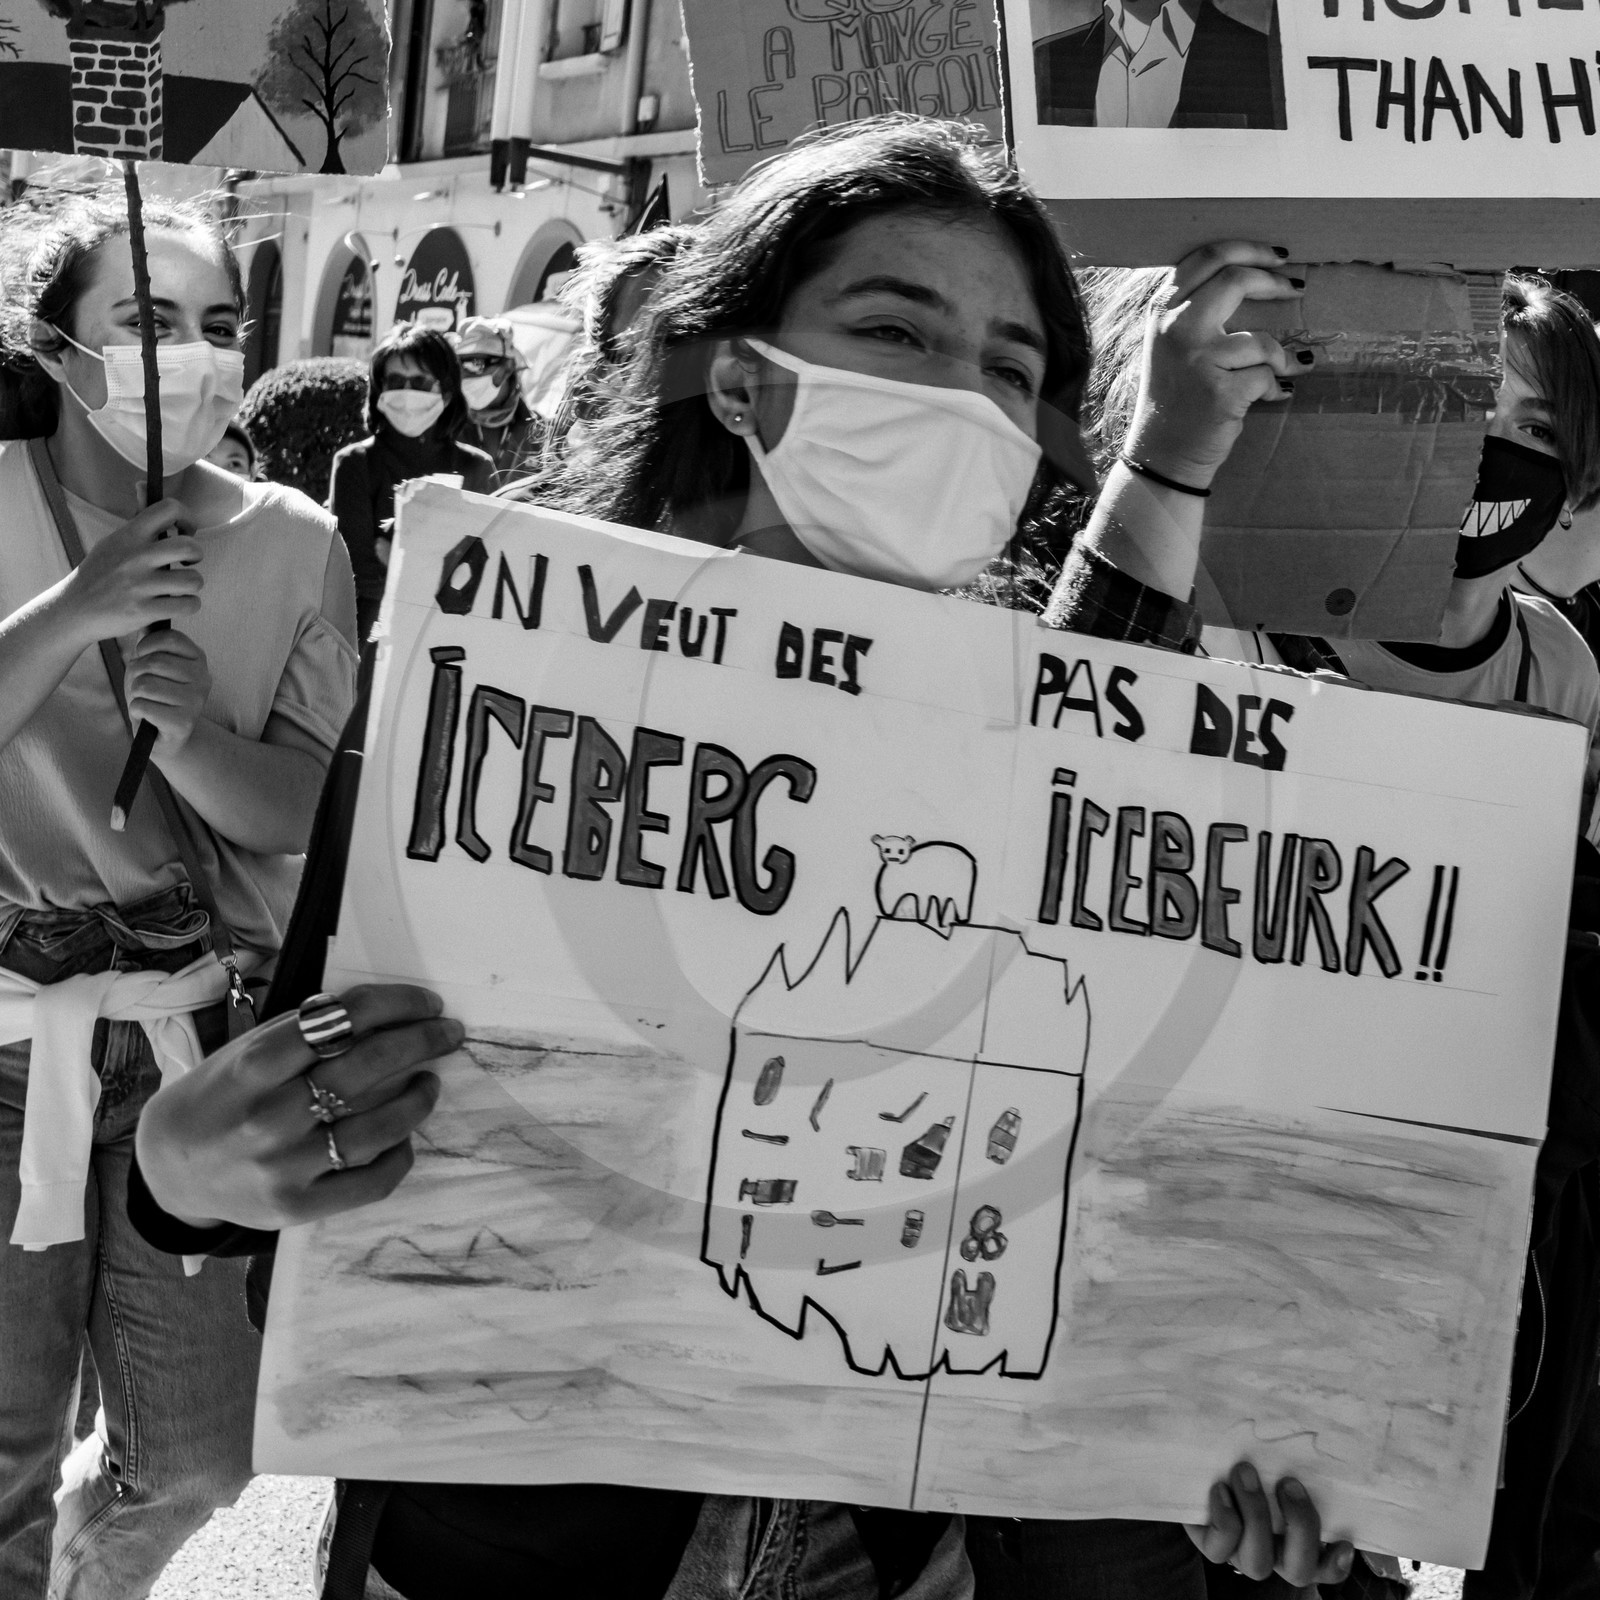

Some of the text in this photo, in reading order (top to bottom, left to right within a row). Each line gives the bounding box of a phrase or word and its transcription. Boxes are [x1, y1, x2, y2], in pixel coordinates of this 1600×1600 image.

[763, 26, 796, 82] A
[717, 83, 788, 154] LE
[1307, 56, 1524, 144] THAN
[435, 535, 874, 695] ON VEUT DES
[1030, 652, 1295, 772] PAS DES
